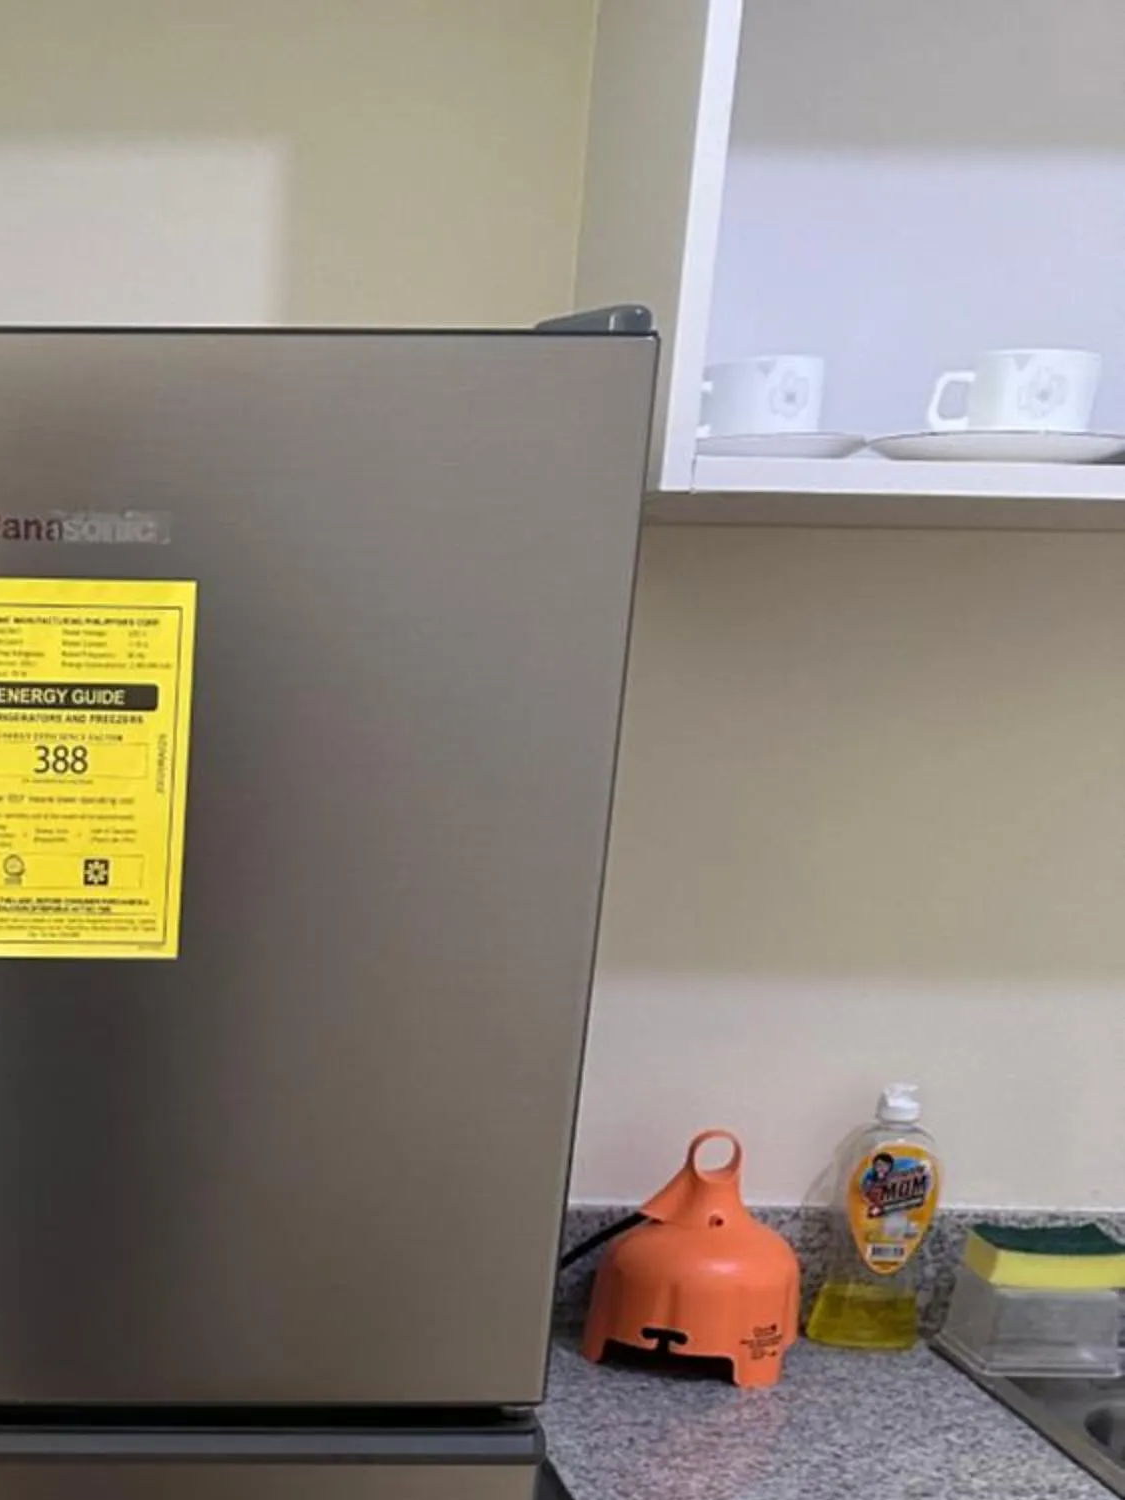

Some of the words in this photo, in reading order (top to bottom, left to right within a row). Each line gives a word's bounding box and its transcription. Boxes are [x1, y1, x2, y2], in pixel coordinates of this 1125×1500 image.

[70, 688, 126, 705] GUIDE
[64, 713, 87, 724] AND
[89, 714, 145, 725] FREEZERS
[33, 744, 89, 775] 388
[882, 1175, 926, 1202] MOM
